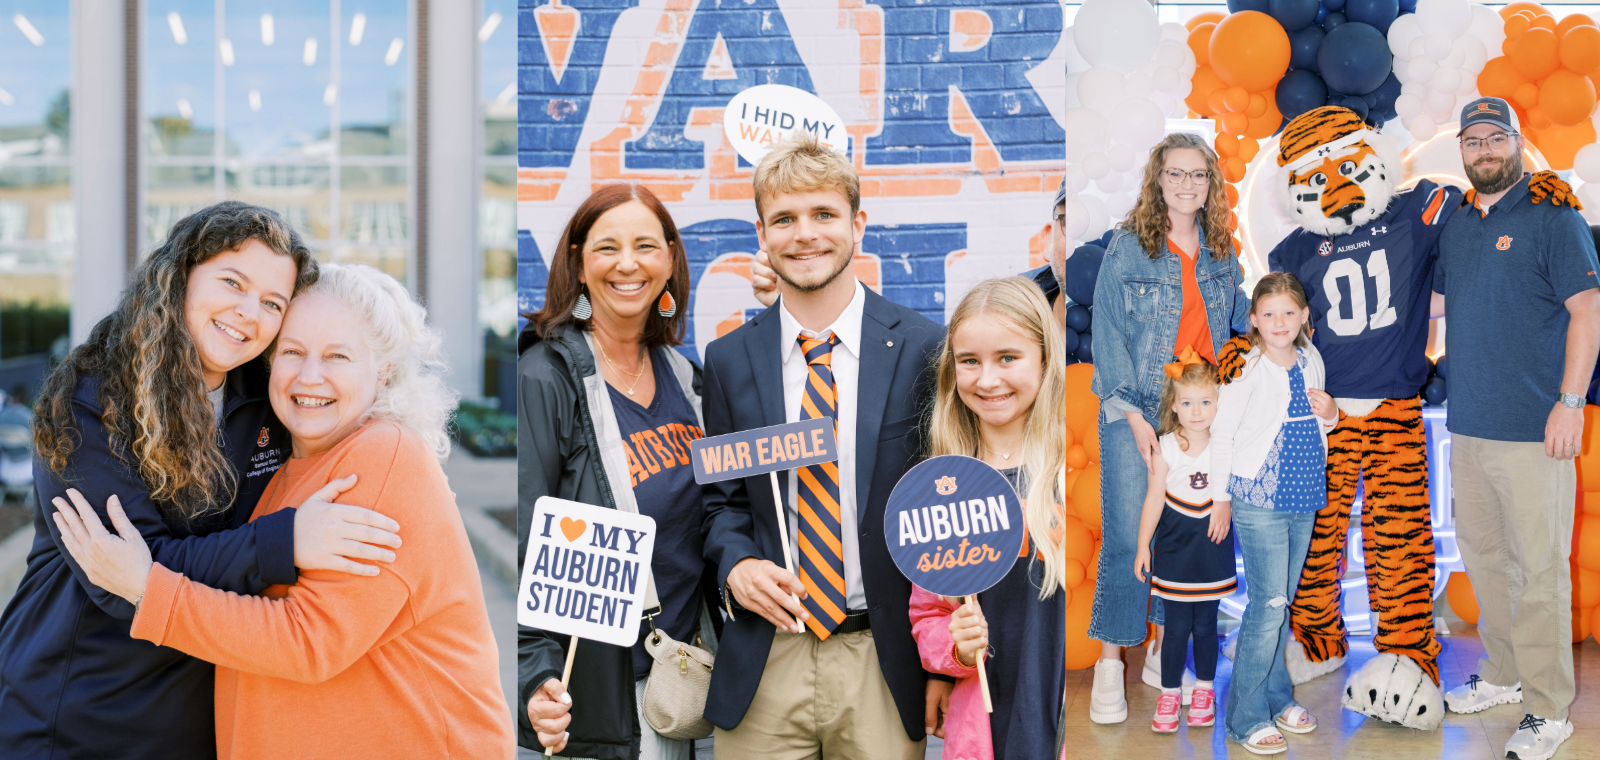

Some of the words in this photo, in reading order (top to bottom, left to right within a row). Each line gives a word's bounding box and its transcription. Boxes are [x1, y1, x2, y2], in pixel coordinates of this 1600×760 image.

[741, 103, 747, 119] I
[754, 106, 795, 130] HID
[803, 117, 835, 139] MY
[1337, 240, 1371, 253] AUBURN
[1322, 248, 1398, 336] 01
[250, 448, 280, 462] AUBURN
[700, 441, 752, 475] WAR
[755, 428, 828, 473] EAGLE
[539, 512, 556, 538] I
[589, 522, 647, 555] MY
[899, 495, 1011, 546] AUBURN
[532, 544, 640, 595] AUBURN
[916, 538, 1002, 573] sister
[526, 581, 633, 629] STUDENT
